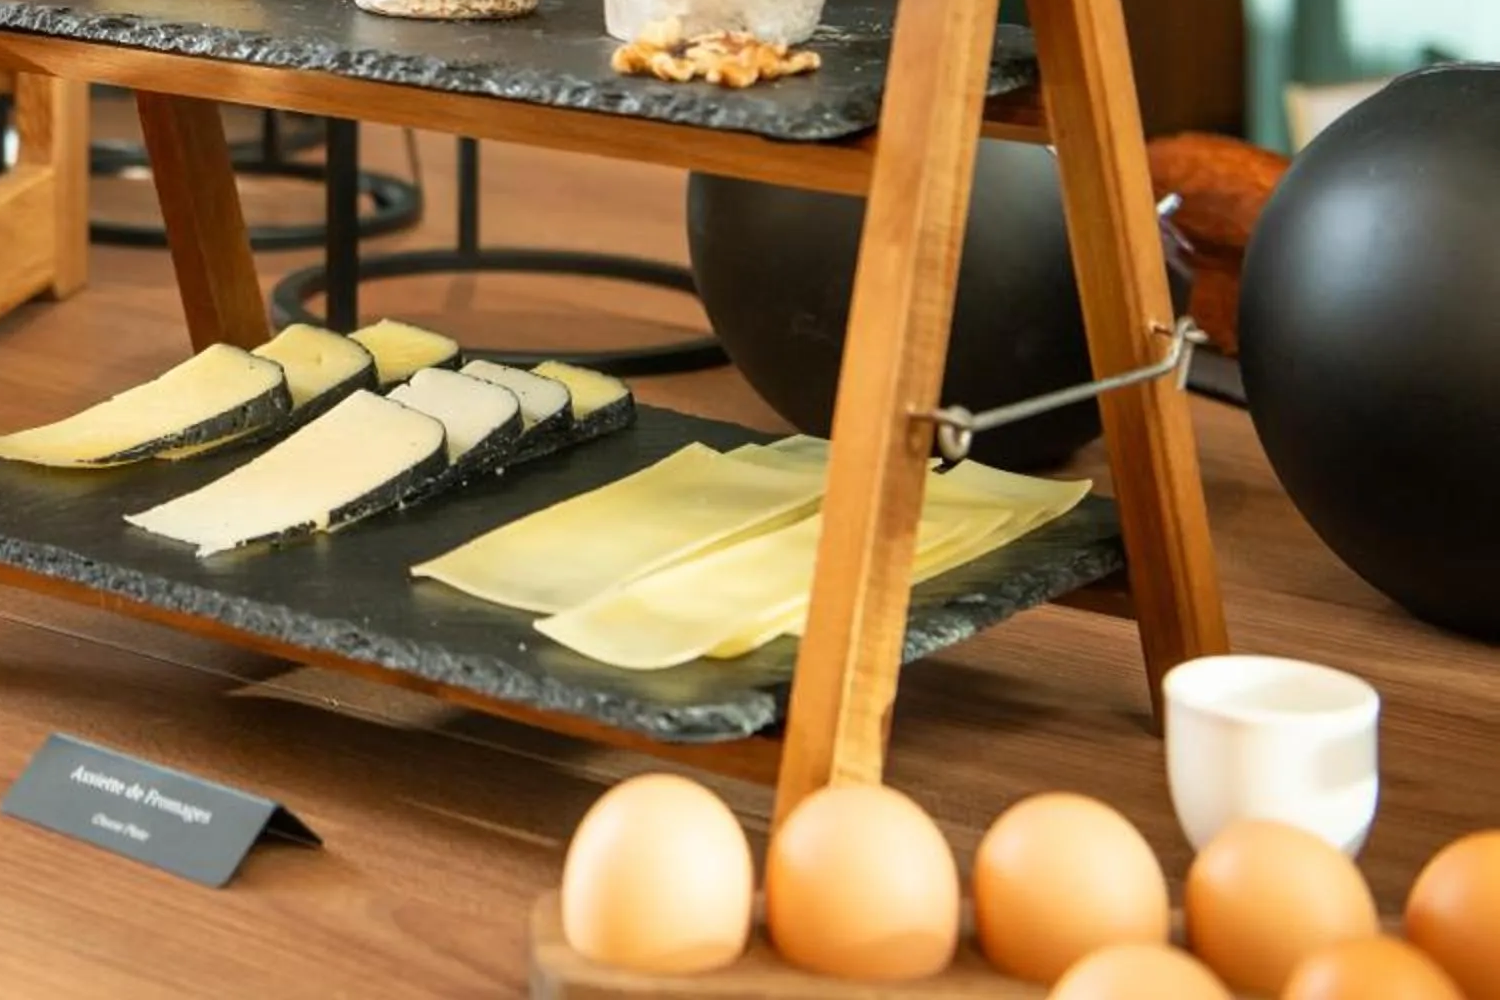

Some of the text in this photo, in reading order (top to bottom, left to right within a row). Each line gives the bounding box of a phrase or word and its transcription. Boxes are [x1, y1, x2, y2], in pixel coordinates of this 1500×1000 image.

[70, 765, 213, 825] Assiette de Fromages
